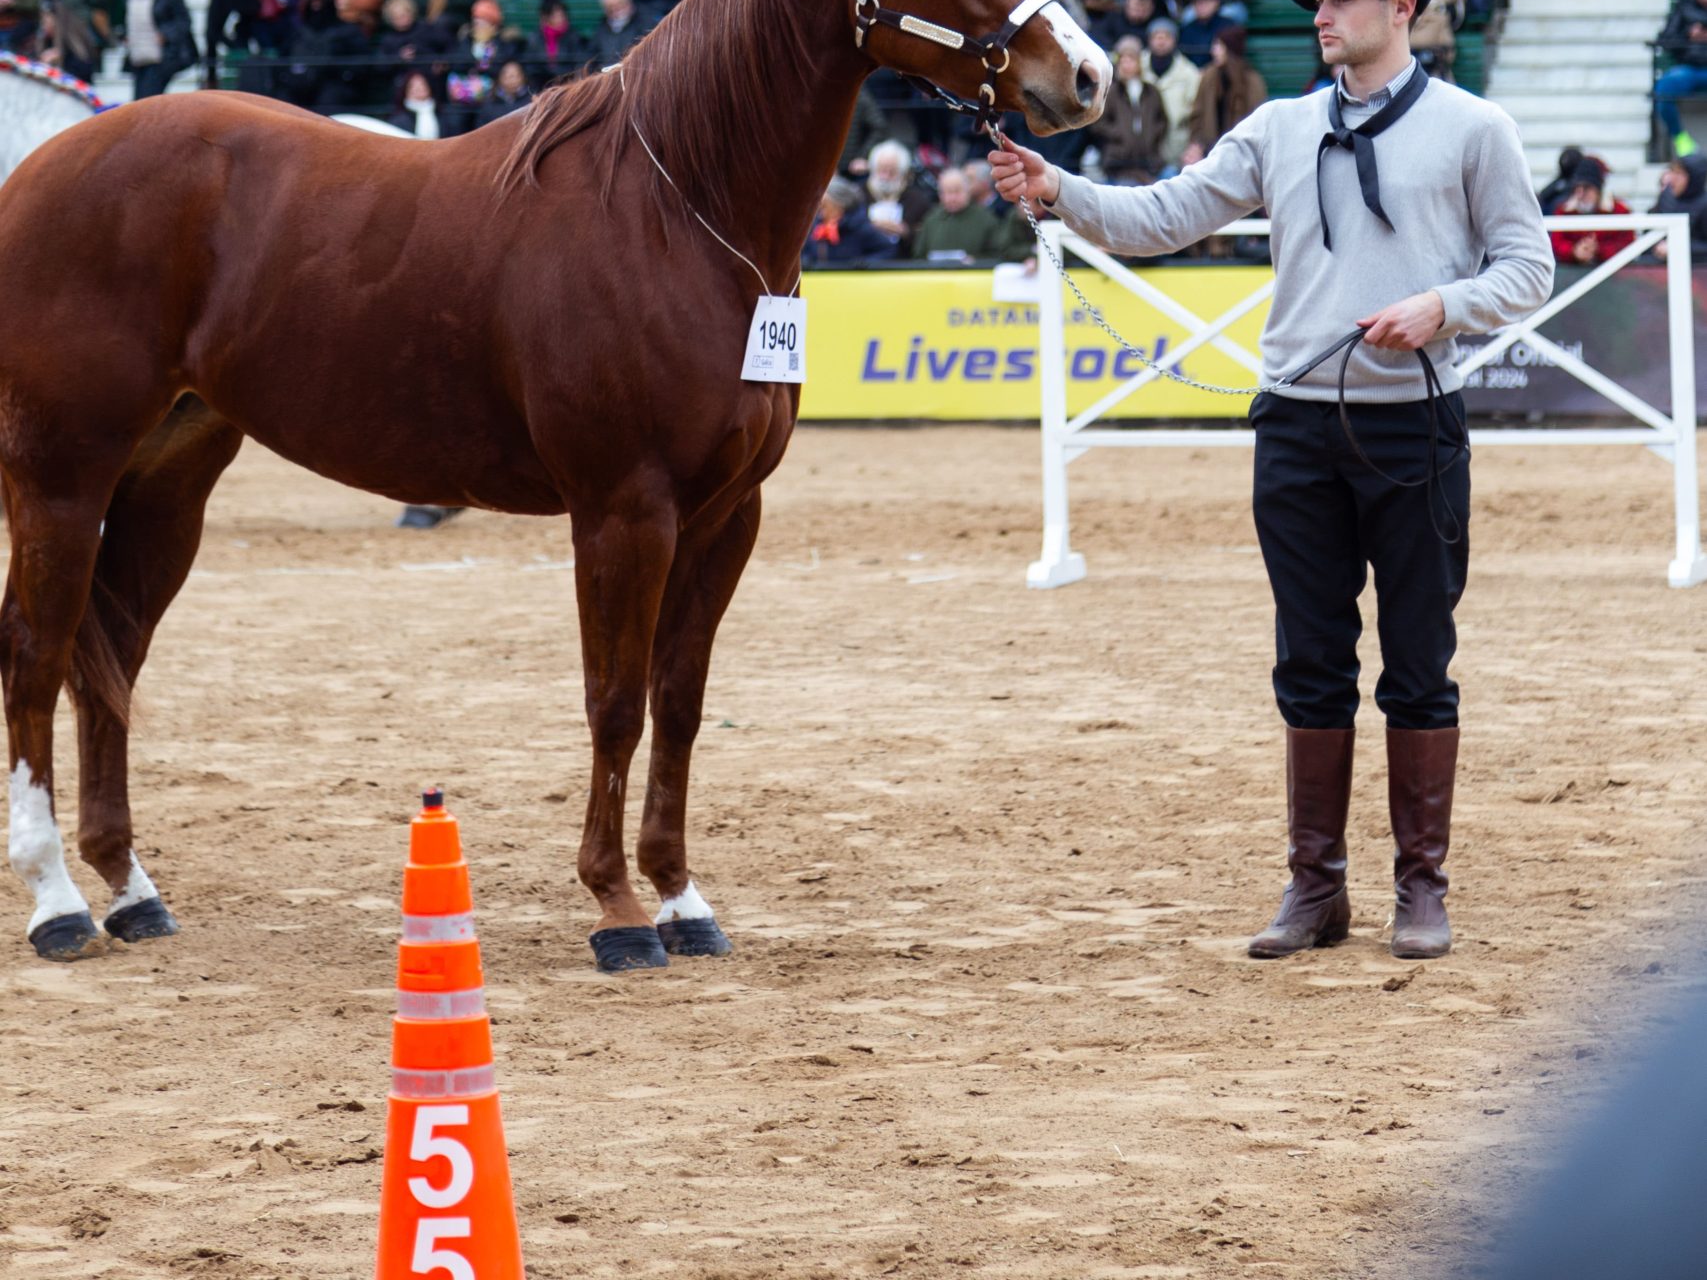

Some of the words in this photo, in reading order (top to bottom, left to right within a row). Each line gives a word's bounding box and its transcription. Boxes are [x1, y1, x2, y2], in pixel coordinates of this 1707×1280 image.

[760, 320, 796, 351] 1940
[948, 308, 1103, 326] DATAMRS
[861, 337, 1184, 381] Livesock
[408, 1105, 474, 1209] 5
